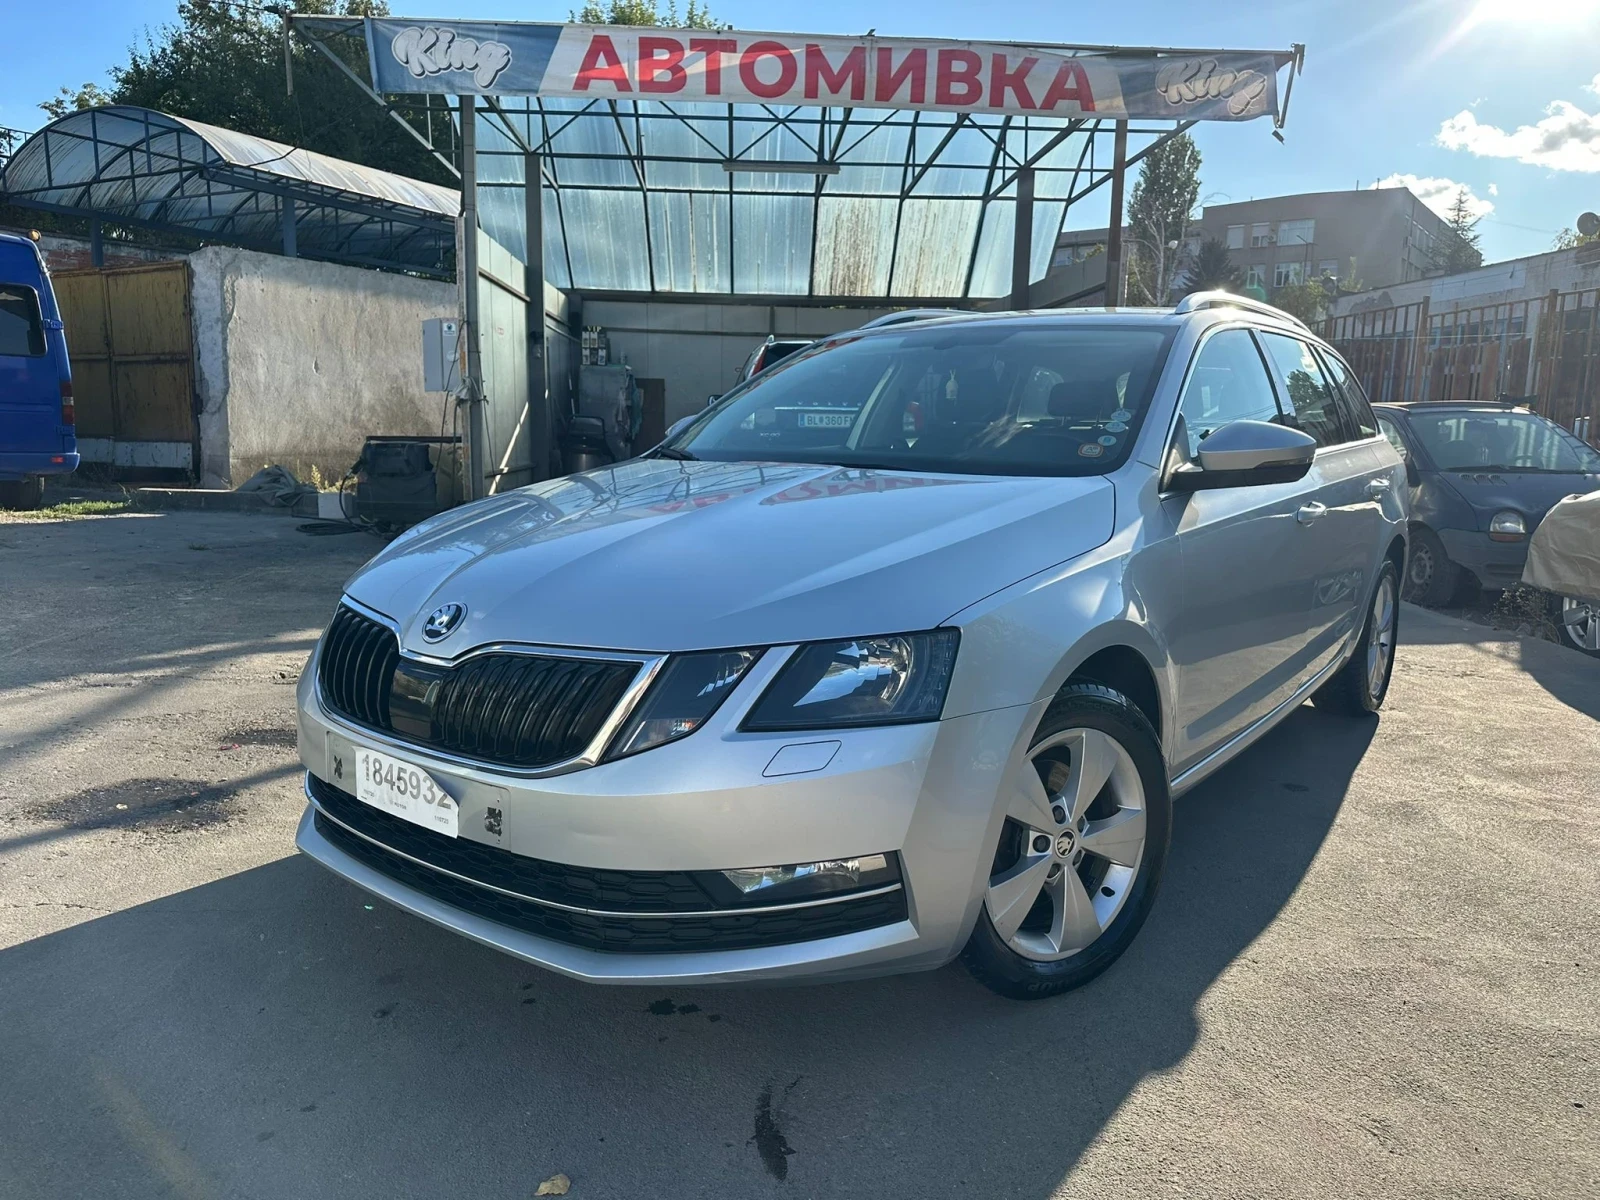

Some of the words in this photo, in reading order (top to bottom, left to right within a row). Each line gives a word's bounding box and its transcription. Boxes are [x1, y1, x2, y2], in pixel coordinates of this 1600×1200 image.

[391, 27, 512, 89] King
[572, 34, 1096, 112] АВТОМИВКА
[1155, 58, 1268, 117] King
